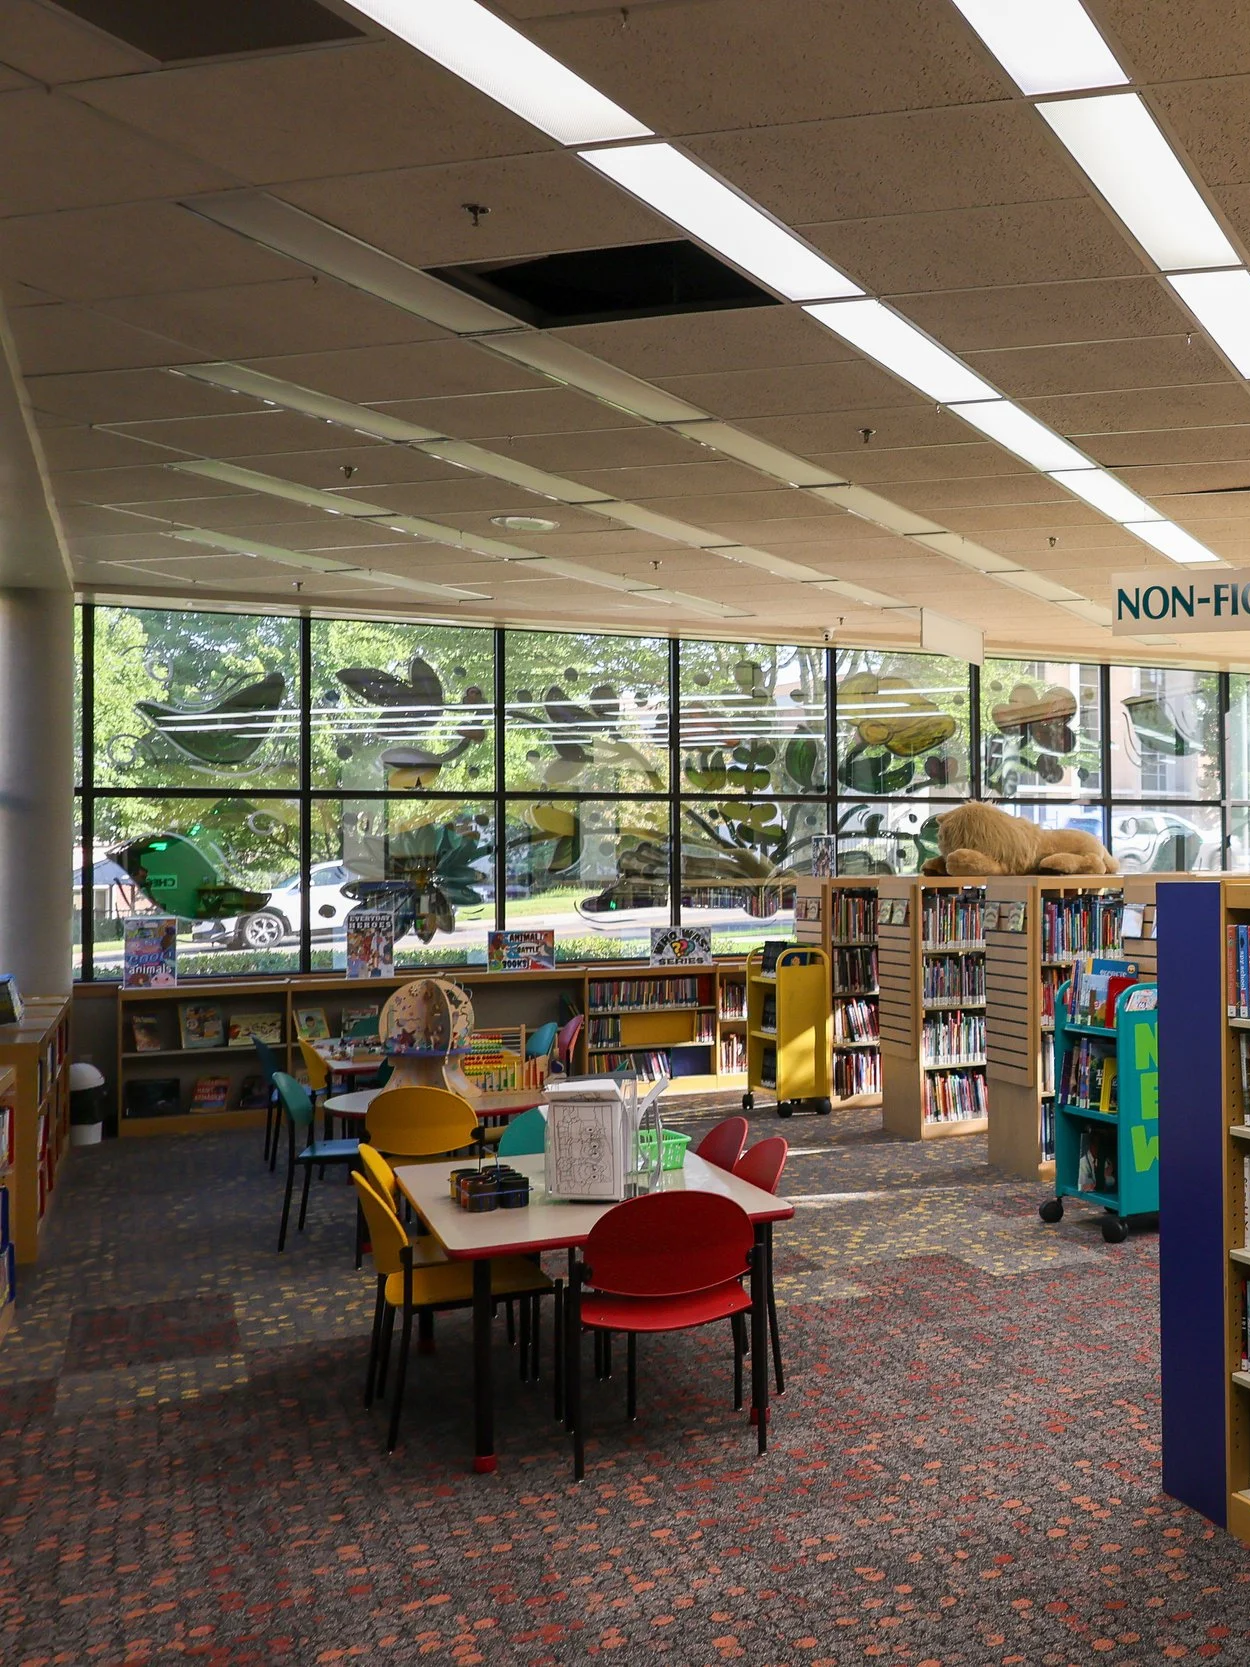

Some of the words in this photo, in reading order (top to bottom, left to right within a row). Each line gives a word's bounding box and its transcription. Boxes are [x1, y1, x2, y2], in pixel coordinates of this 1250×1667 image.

[350, 914, 391, 922] EVERYDAY
[349, 921, 391, 929] HEROES
[659, 957, 704, 965] SERIES
[1239, 951, 1247, 965] spy
[129, 963, 172, 974] animals
[1239, 967, 1247, 991] school
